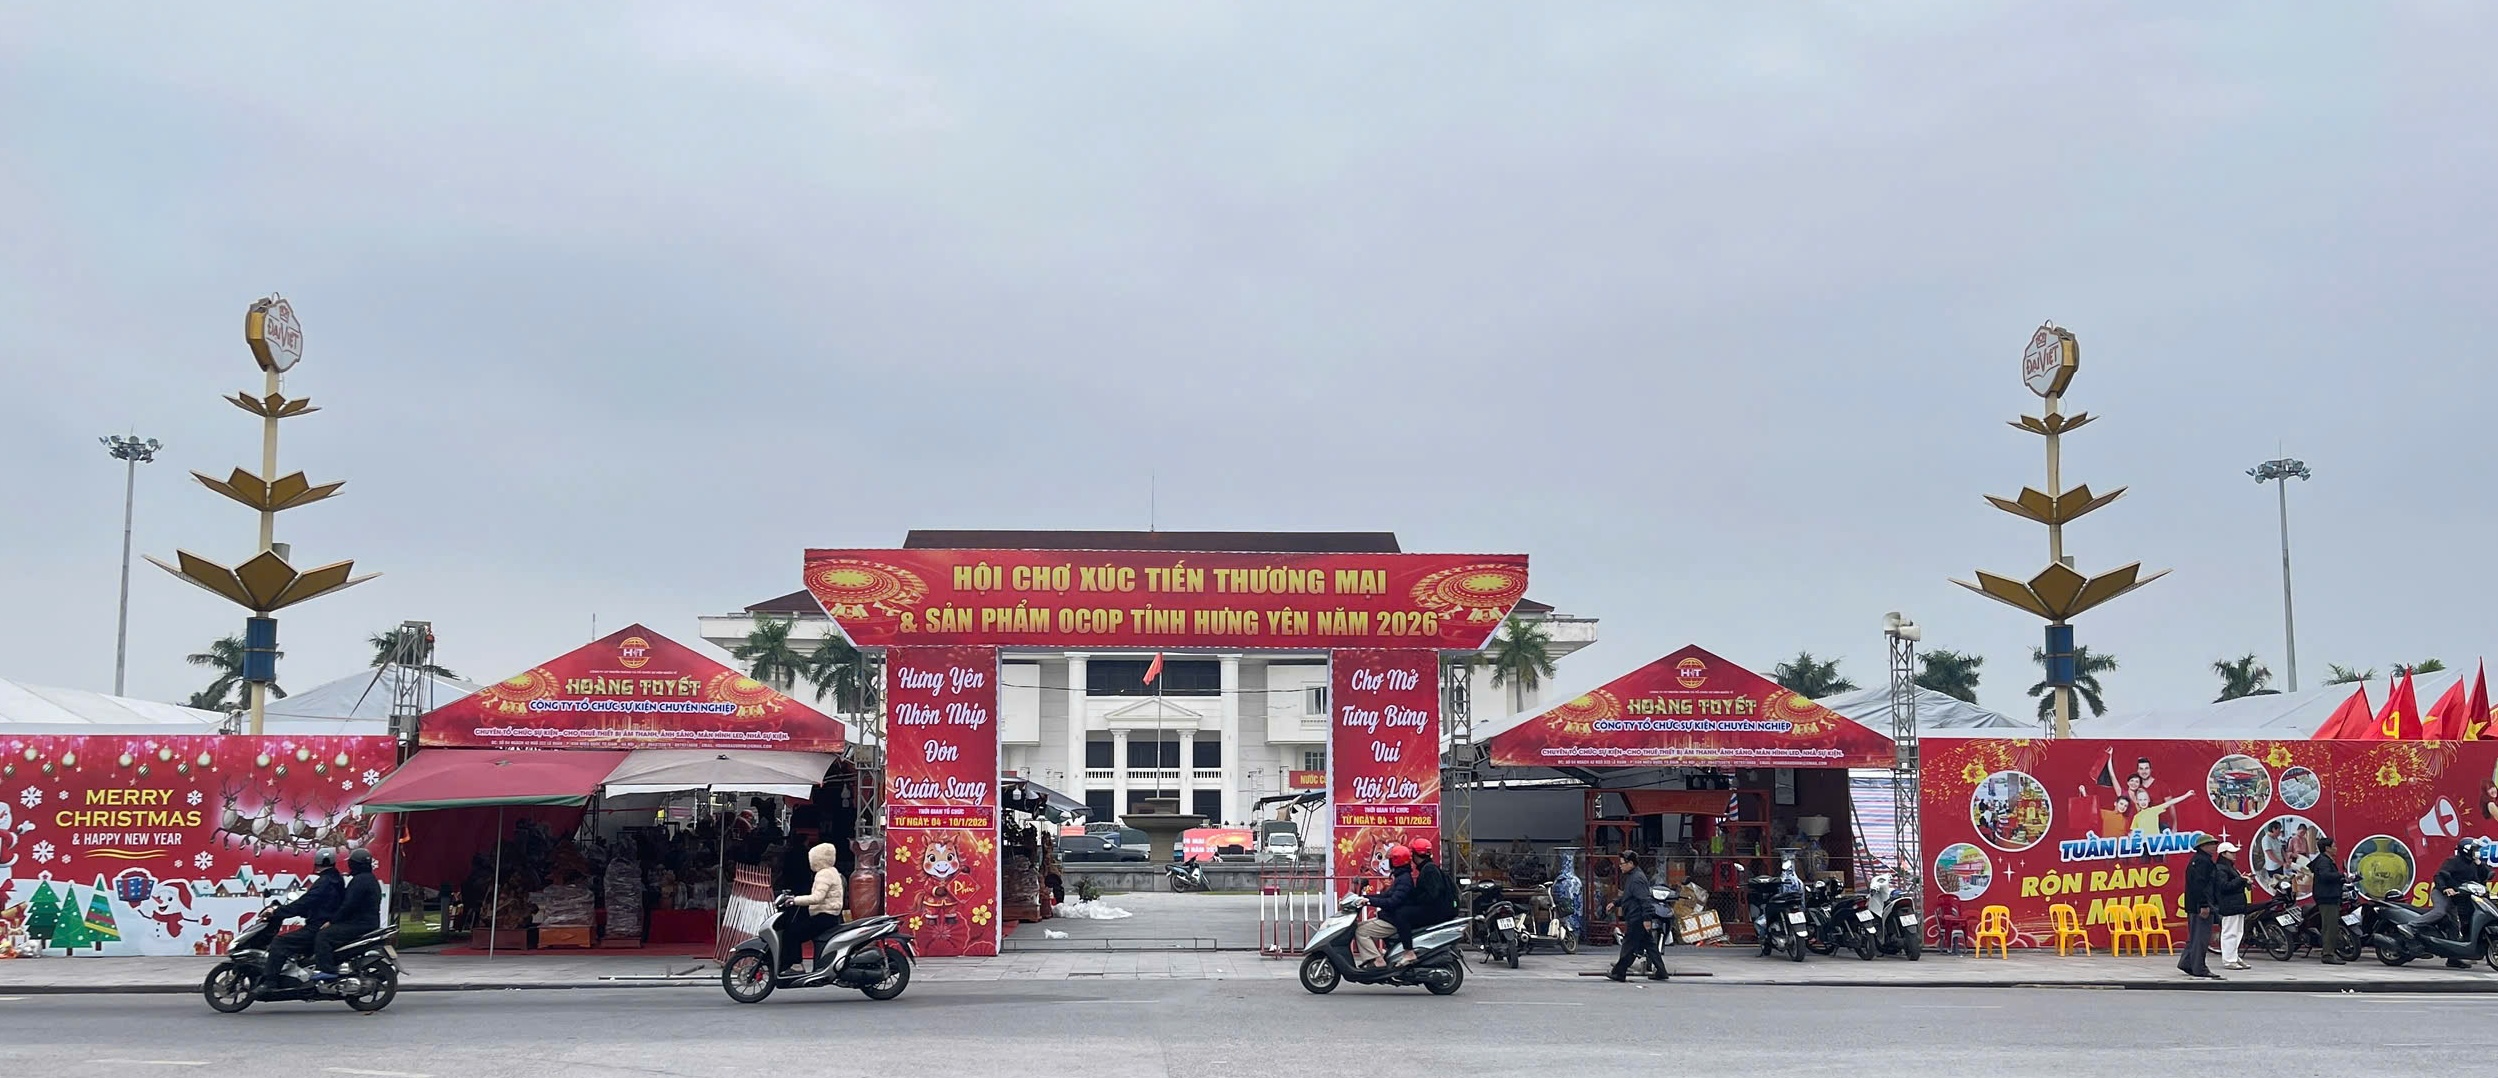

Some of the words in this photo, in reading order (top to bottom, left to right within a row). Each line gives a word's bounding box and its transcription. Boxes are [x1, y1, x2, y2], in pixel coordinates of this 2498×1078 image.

[953, 562, 1002, 595] HỘI
[1012, 563, 1072, 595] CHỢ
[1080, 563, 1135, 592] XÚC
[1145, 560, 1203, 593] TIẾN
[1213, 565, 1325, 595] THƯƠNG
[1335, 569, 1387, 599] MẠI
[900, 611, 918, 633] &
[925, 601, 973, 633] SẢN
[981, 599, 1050, 633] PHẨM
[1058, 608, 1124, 634] OCOP
[1130, 603, 1185, 635] TỈNH
[1194, 606, 1259, 635] HƯNG
[1266, 606, 1309, 636] YÊN
[1317, 606, 1369, 636] NĂM
[1376, 610, 1438, 637] 2026
[565, 676, 634, 696] HOÀNG
[640, 674, 702, 696] TUYẾT
[898, 667, 945, 697] Hưng
[949, 666, 985, 695] Yên
[1351, 668, 1384, 695] Chợ
[1387, 668, 1419, 691] Mở
[530, 699, 559, 711] CÔNG
[561, 701, 573, 711] TY
[575, 697, 590, 711] TỔ
[591, 700, 619, 712] CHỨC
[619, 701, 634, 713] SỰ
[635, 701, 658, 713] KIỆN
[659, 701, 699, 712] CHUYÊN
[700, 702, 736, 714] NGHIỆP
[895, 703, 942, 729] Nhộn
[946, 702, 988, 731] Nhịp
[1627, 695, 1694, 715] HOÀNG
[1698, 694, 1757, 715] TUYẾT
[1342, 704, 1380, 735] Tưng
[1384, 704, 1429, 735] Bừng
[1594, 719, 1624, 731] CÔNG
[1624, 721, 1637, 731] TY
[1637, 717, 1652, 731] TỔ
[1653, 720, 1680, 732] CHỨC
[1680, 721, 1694, 733] SỰ
[1694, 721, 1717, 732] KIỆN
[1718, 720, 1757, 732] CHUYÊN
[1757, 721, 1792, 733] NGHIỆP
[923, 739, 960, 763] Đón
[1370, 740, 1402, 763] Vui
[85, 789, 174, 806] MERRY
[894, 776, 941, 799] Xuân
[944, 776, 988, 806] Sang
[1352, 776, 1383, 803] Hội
[1386, 776, 1420, 800] Lớn
[55, 810, 202, 827] CHRISTMAS
[895, 816, 907, 826] TỪ
[906, 815, 930, 826] NGÀY:
[931, 817, 942, 826] 04
[949, 817, 988, 826] 10/1/2026
[1342, 815, 1353, 825] TỪ
[1353, 814, 1376, 825] NGÀY:
[1377, 816, 1388, 825] 04
[1394, 816, 1432, 825] 10/1/2026
[72, 833, 81, 845] &
[84, 833, 122, 845] HAPPY
[124, 833, 150, 845] NEW
[153, 833, 182, 845] YEAR
[2061, 832, 2115, 859] TUẦN
[2120, 830, 2143, 855] LỄ
[2020, 869, 2083, 902] RỘN
[2090, 864, 2170, 892] RÀNG
